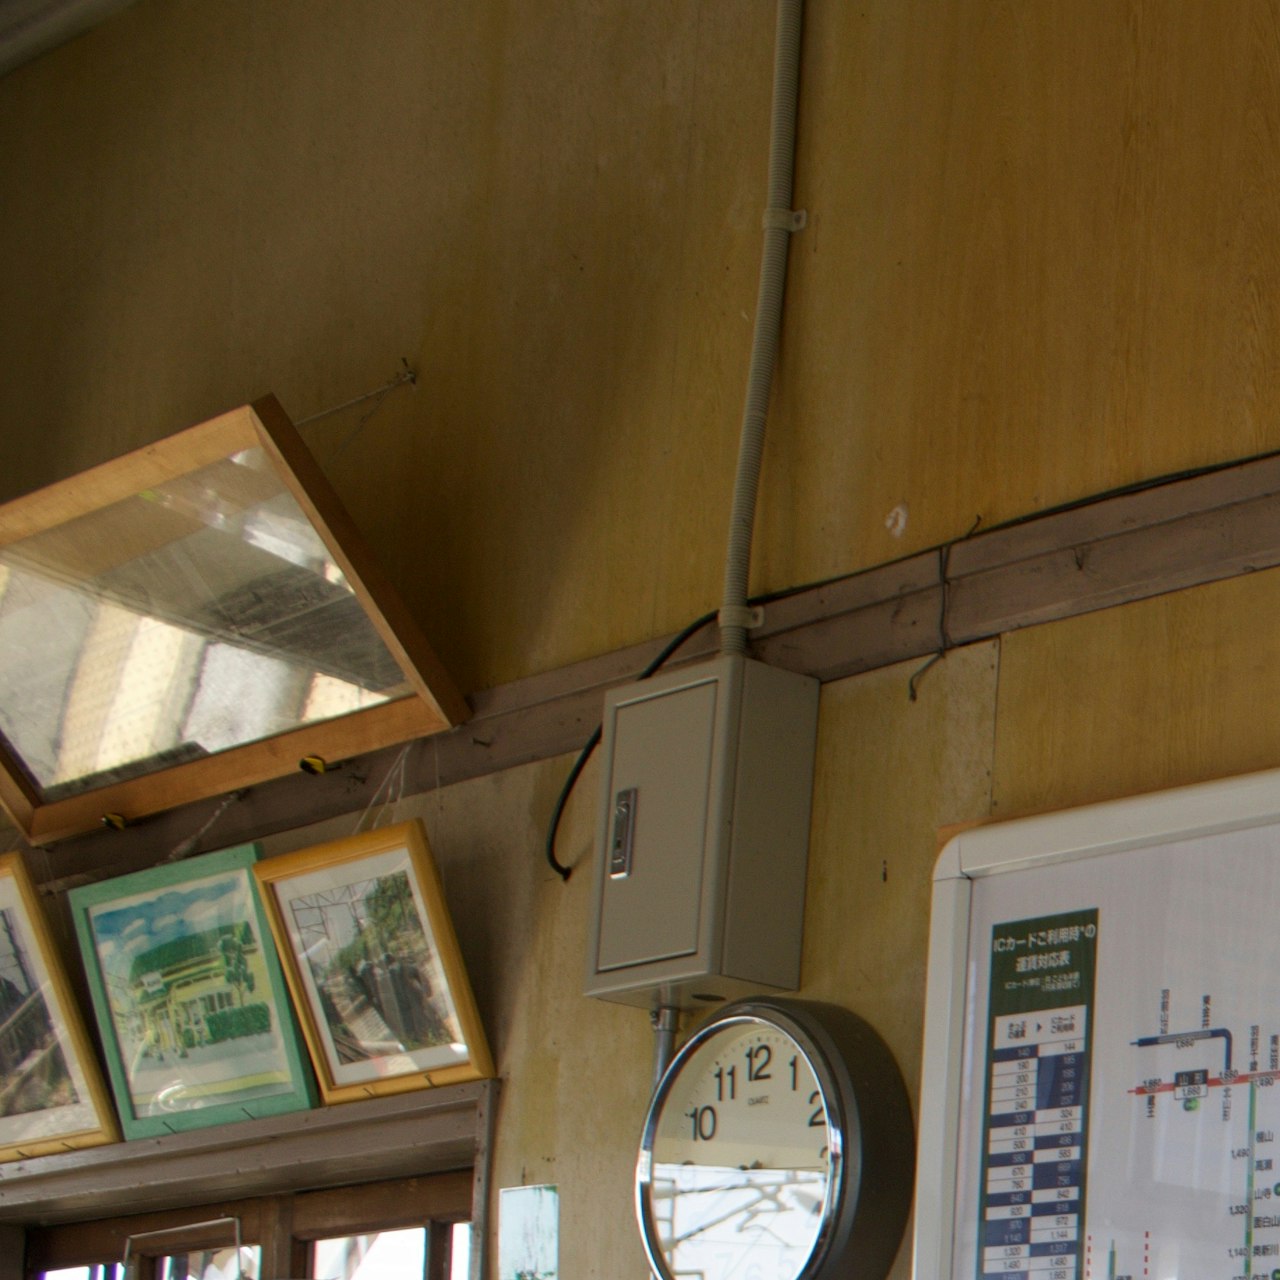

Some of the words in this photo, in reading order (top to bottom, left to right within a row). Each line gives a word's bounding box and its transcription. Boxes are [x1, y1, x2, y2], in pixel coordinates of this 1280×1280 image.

[746, 1044, 772, 1081] 12
[789, 1055, 797, 1091] 1
[715, 1065, 736, 1101] 11
[690, 1105, 716, 1141] 10
[809, 1090, 826, 1127] 2
